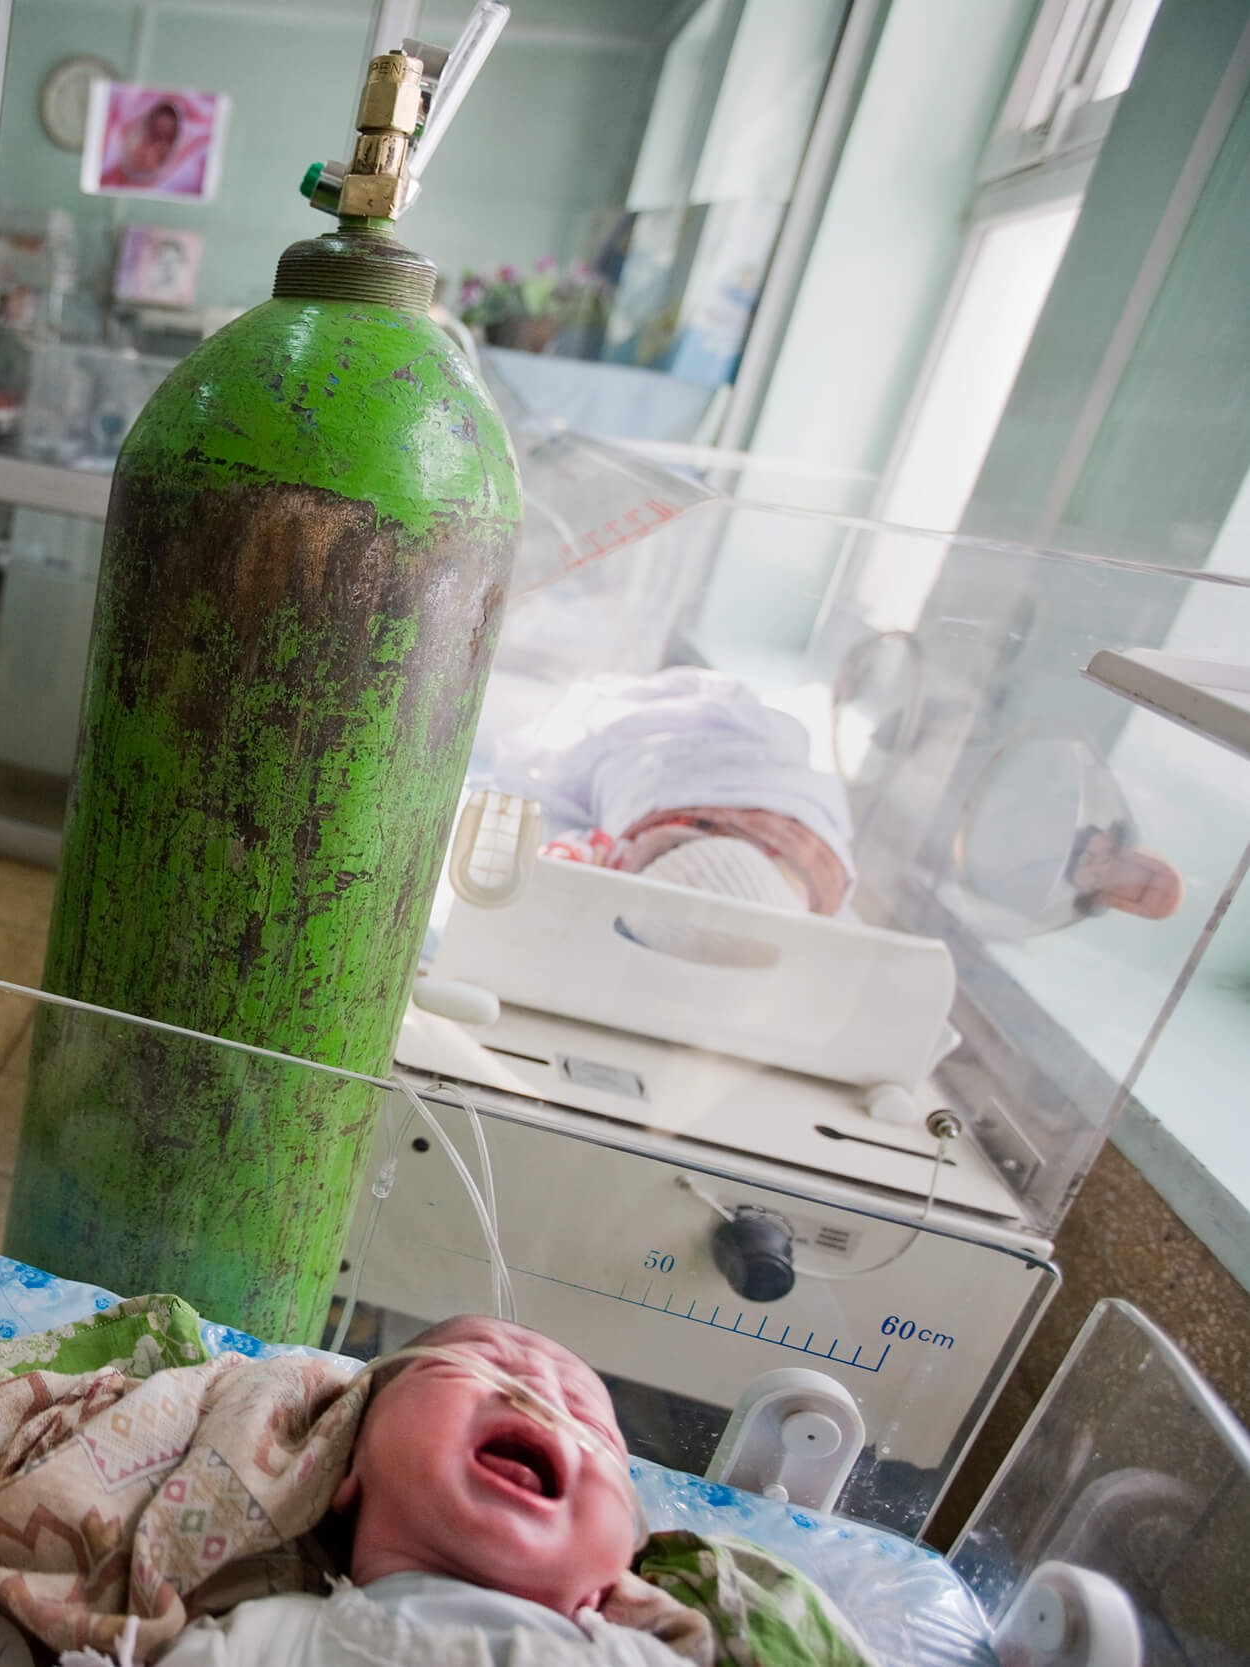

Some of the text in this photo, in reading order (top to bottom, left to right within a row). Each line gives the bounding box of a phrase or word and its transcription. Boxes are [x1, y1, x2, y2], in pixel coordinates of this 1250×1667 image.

[370, 61, 403, 75] PEN
[644, 1249, 675, 1273] 50
[880, 1315, 955, 1350] 60cm
